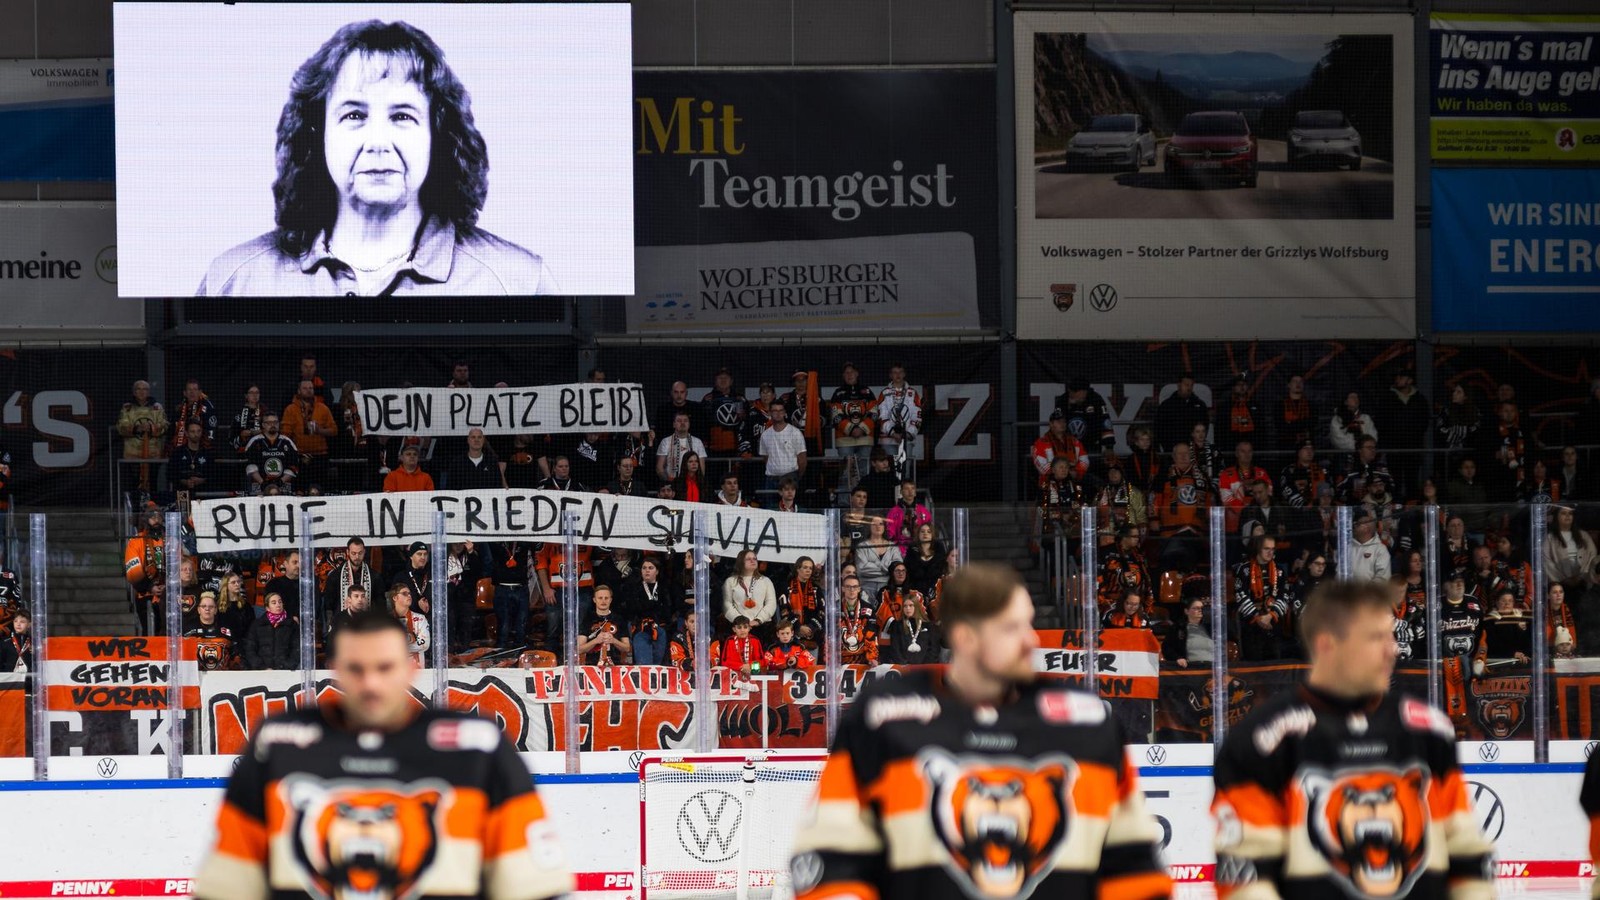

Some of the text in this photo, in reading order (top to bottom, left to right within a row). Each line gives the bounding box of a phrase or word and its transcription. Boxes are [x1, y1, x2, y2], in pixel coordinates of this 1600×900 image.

[1541, 36, 1593, 61] mal
[30, 68, 99, 77] VOLKSWAGEN
[47, 79, 99, 87] Immobilien
[1438, 64, 1480, 89] ins
[1484, 65, 1552, 96] Auge
[1438, 97, 1573, 112] Wir haben da was.
[635, 97, 745, 155] Mit
[688, 158, 957, 222] Teamgeist
[1487, 202, 1543, 226] WIR
[1041, 246, 1123, 261] Volkswagen
[1137, 246, 1185, 259] Stolzer
[1188, 247, 1239, 259] Partner
[1241, 245, 1261, 259] der
[1264, 246, 1317, 261] Grizzlys
[1320, 246, 1389, 261] Wolfsburg
[699, 262, 899, 291] WOLFSBURGER
[700, 283, 900, 311] NACHRICHTEN
[363, 392, 432, 431] DEIN
[449, 391, 541, 429] PLATZ
[559, 387, 645, 427] BLEIBT
[211, 500, 331, 544] RUHE
[366, 497, 406, 539] IN
[430, 495, 619, 541] FRIEDEN
[87, 638, 151, 658] WIR
[70, 663, 171, 685] GEHEN
[71, 685, 170, 708] VORAN
